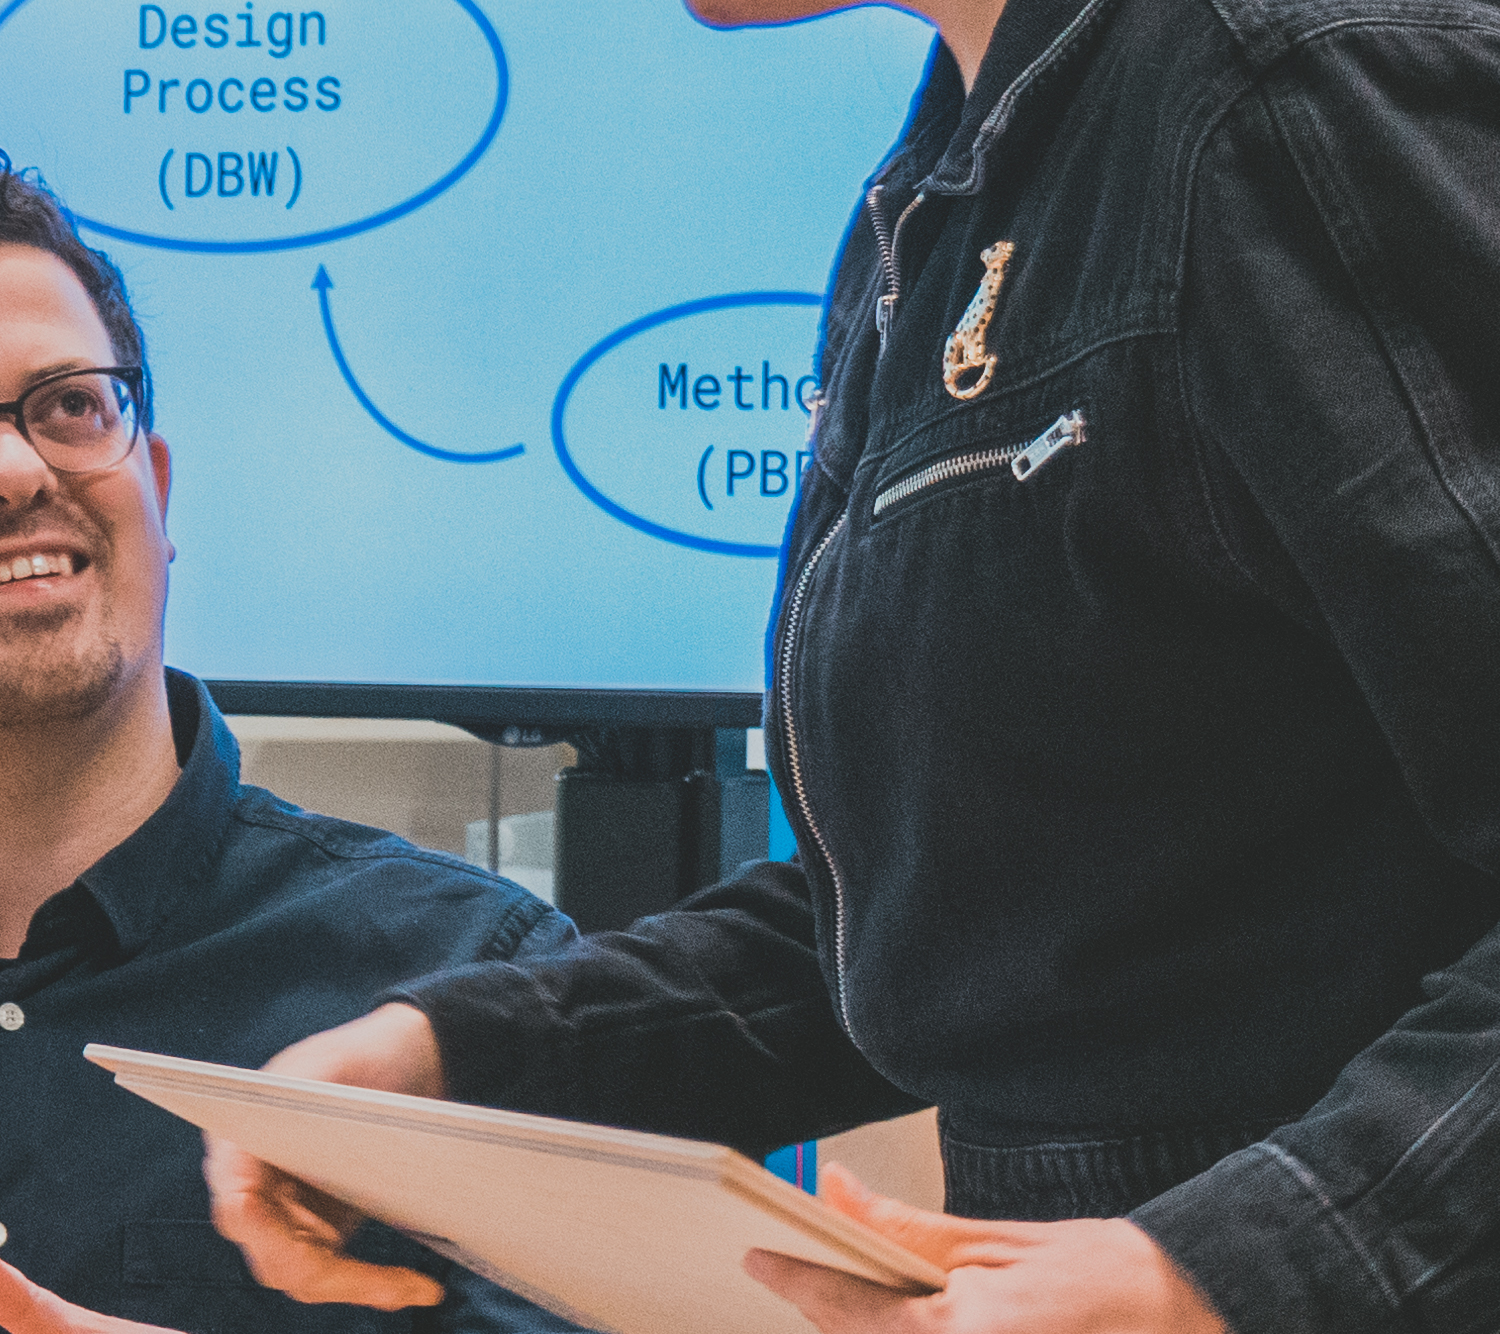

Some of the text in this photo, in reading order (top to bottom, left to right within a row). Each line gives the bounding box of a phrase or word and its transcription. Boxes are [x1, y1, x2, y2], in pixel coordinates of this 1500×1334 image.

[138, 1, 326, 60] Design
[122, 68, 343, 116] Process
[155, 148, 306, 208] (DBW)
